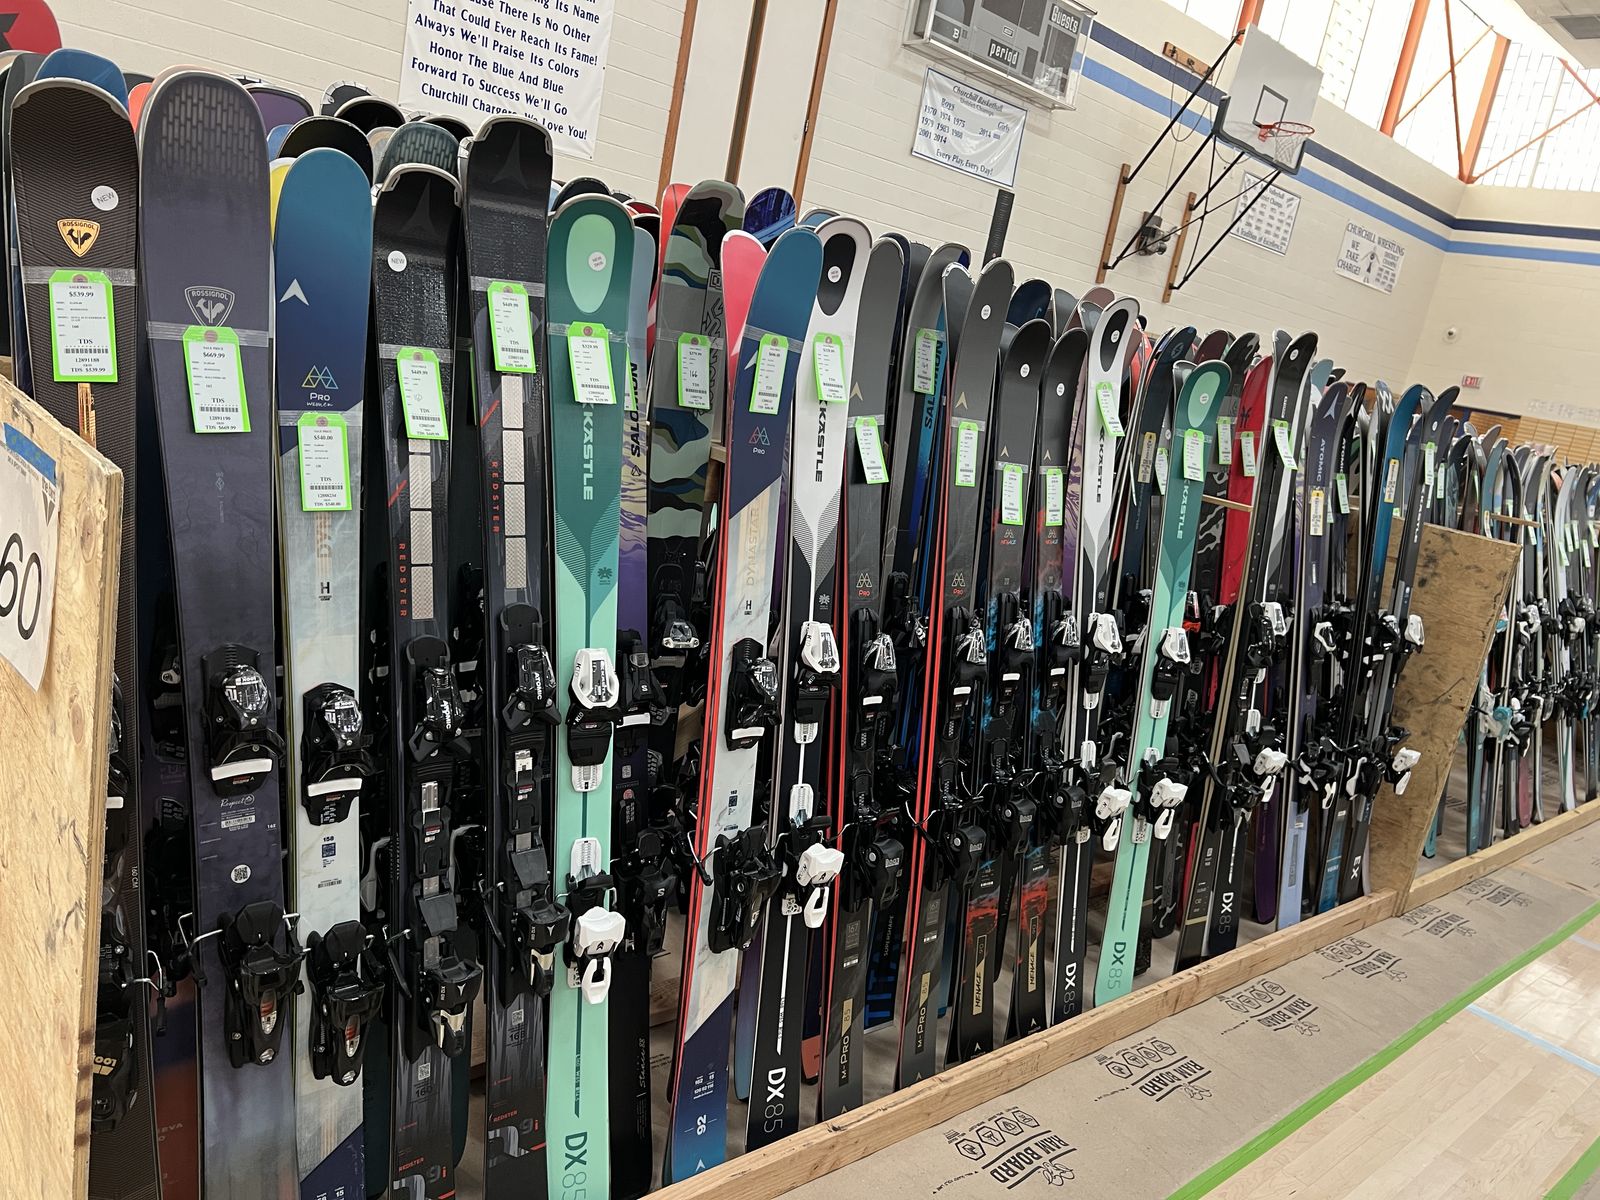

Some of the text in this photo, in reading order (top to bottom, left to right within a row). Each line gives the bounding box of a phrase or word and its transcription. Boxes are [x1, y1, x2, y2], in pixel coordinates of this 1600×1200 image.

[500, 1, 528, 21] There
[532, 13, 541, 25] Is
[545, 18, 559, 31] No
[563, 24, 591, 43] Other
[556, 1, 600, 24] Its Name
[1051, 5, 1079, 34] Guests
[433, 0, 456, 17] That
[461, 10, 491, 29] Could
[495, 20, 516, 38] Ever
[521, 30, 550, 50] Reach
[555, 42, 567, 56] Its
[571, 50, 598, 66] Fame!
[415, 14, 580, 79] Always We'll Praise Its Colors
[989, 43, 1019, 65] period
[430, 41, 564, 94] Honor The Blue And Blue
[412, 57, 568, 116] Forward To Success We'll Go
[952, 86, 978, 102] Churchill
[421, 83, 469, 107] Churchill
[568, 125, 588, 140] You!
[924, 105, 938, 116] 1970
[954, 117, 966, 128] 1975
[941, 98, 956, 111] Boys
[919, 128, 947, 144] 2001 2014
[979, 128, 991, 138] 2014
[937, 149, 994, 175] Every Play, Every Day!
[96, 192, 115, 205] NEW
[62, 222, 96, 230] ROSSIGNOL
[1347, 223, 1405, 257] CHURCHILL WRESTLING
[1352, 240, 1361, 251] WE
[1346, 250, 1360, 263] TAKE
[192, 290, 229, 301] ROSSIGNOL
[690, 370, 698, 378] 166
[1465, 376, 1480, 386] EXIT
[1317, 438, 1326, 483] ATOMIC
[491, 461, 500, 533] REDSTER
[321, 582, 330, 594] H
[399, 544, 408, 617] REDSTER
[746, 600, 752, 610] H
[535, 672, 543, 700] ATOMIC
[440, 700, 452, 730] ATOMIC
[1351, 856, 1362, 880] EX
[1218, 892, 1234, 935] DX85
[884, 916, 894, 957] SUPERSHAPE
[1107, 942, 1127, 990] DX85
[1351, 950, 1397, 976] RAM BOARD
[1064, 962, 1077, 1015] DX85
[1257, 998, 1313, 1028] RAM BOARD
[93, 1056, 118, 1067] LOO
[1138, 1060, 1205, 1097] RAM BOARD
[764, 1067, 787, 1134] DX85
[493, 1110, 518, 1123] REDSTER
[697, 1114, 707, 1136] 92
[1034, 1135, 1070, 1155] RAM
[399, 1157, 424, 1172] REDSTER
[562, 1132, 588, 1200] DX85
[990, 1147, 1043, 1184] BOARD
